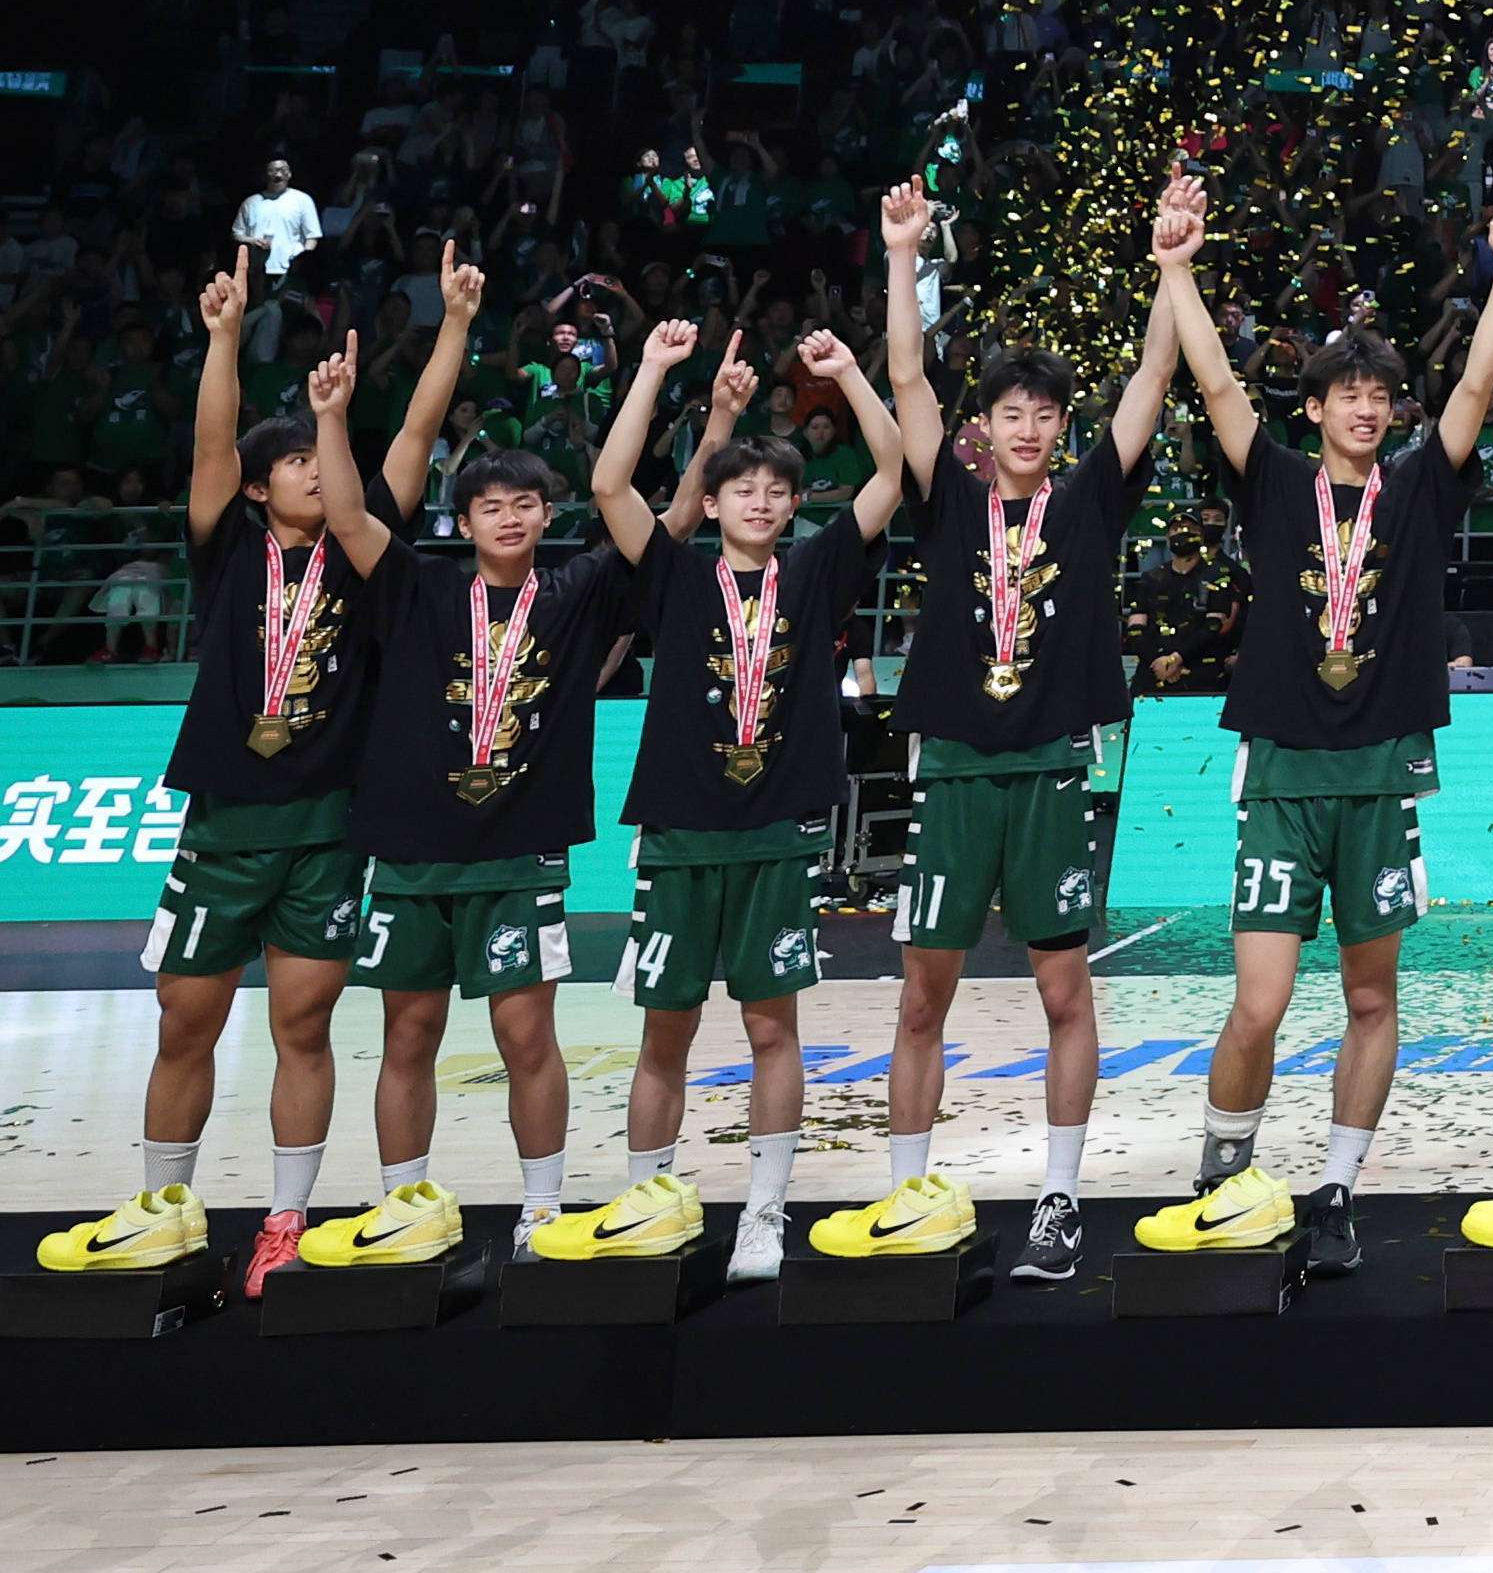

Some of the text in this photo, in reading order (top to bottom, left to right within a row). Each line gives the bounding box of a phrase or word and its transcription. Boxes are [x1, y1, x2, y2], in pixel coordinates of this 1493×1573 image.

[1238, 858, 1297, 914] 35
[182, 905, 209, 959] 1
[356, 911, 396, 969] 5
[637, 931, 673, 988] 4
